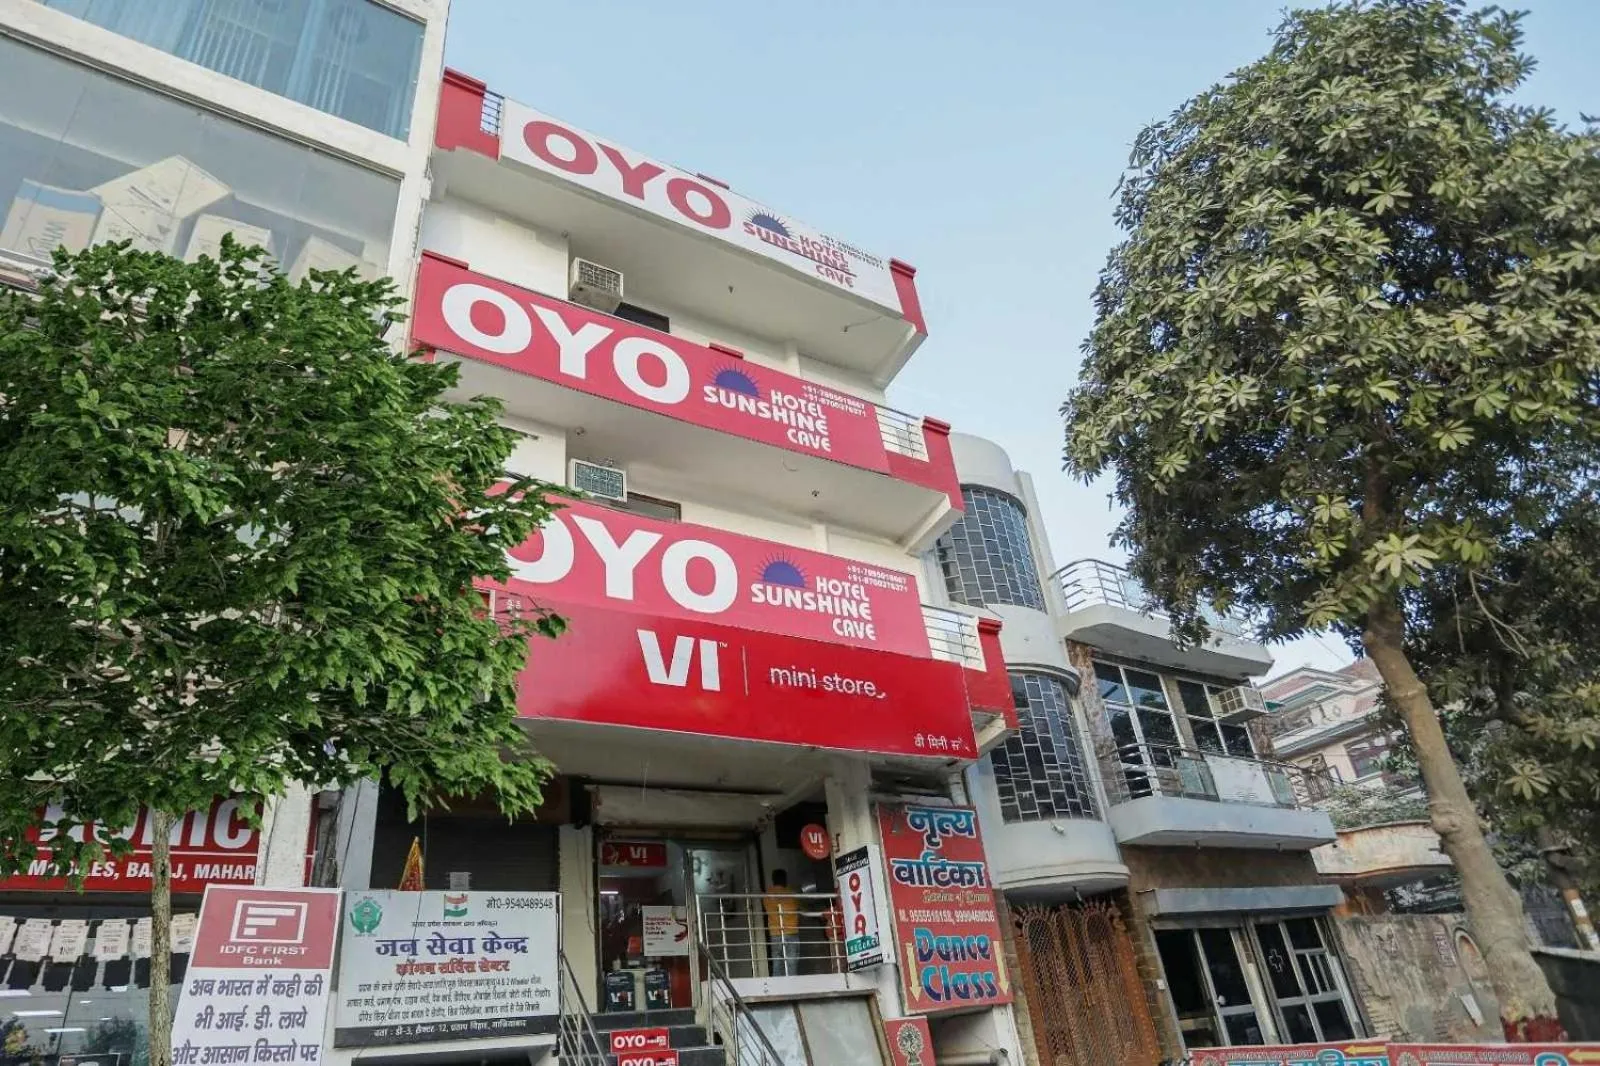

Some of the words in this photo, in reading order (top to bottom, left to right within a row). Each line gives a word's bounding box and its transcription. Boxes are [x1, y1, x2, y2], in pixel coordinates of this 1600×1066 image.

[523, 120, 731, 229] OYO
[743, 222, 850, 272] SUNSHINE
[800, 235, 848, 263] HOTEL
[816, 264, 854, 287] CAVE
[442, 284, 690, 404] OYO
[704, 386, 828, 436] SUNSHINE
[770, 389, 826, 419] HOTEL
[786, 428, 831, 452] CAVE
[750, 583, 872, 620] SUNSHINE
[816, 576, 869, 602] HOTEL
[833, 618, 876, 640] CAVE
[770, 665, 816, 689] mini
[822, 673, 877, 697] store
[905, 806, 976, 848] नृत्य
[890, 850, 985, 888] वाटिका
[219, 945, 258, 954] IDFC
[263, 946, 308, 955] FIRST
[375, 938, 420, 956] जन
[426, 931, 476, 955] सेवा
[481, 930, 529, 954] केन्द्र
[914, 928, 990, 962] Dance
[243, 957, 282, 965] Bank
[189, 979, 216, 996] अब
[217, 979, 254, 996] भारत
[256, 974, 272, 996] में
[304, 974, 323, 996] की
[921, 965, 998, 1002] Class
[195, 1005, 214, 1029] भी
[278, 1006, 307, 1028] लाये
[172, 1040, 199, 1065] और
[200, 1045, 251, 1065] आसान
[300, 1044, 319, 1062] पर
[613, 1035, 646, 1048] OYO
